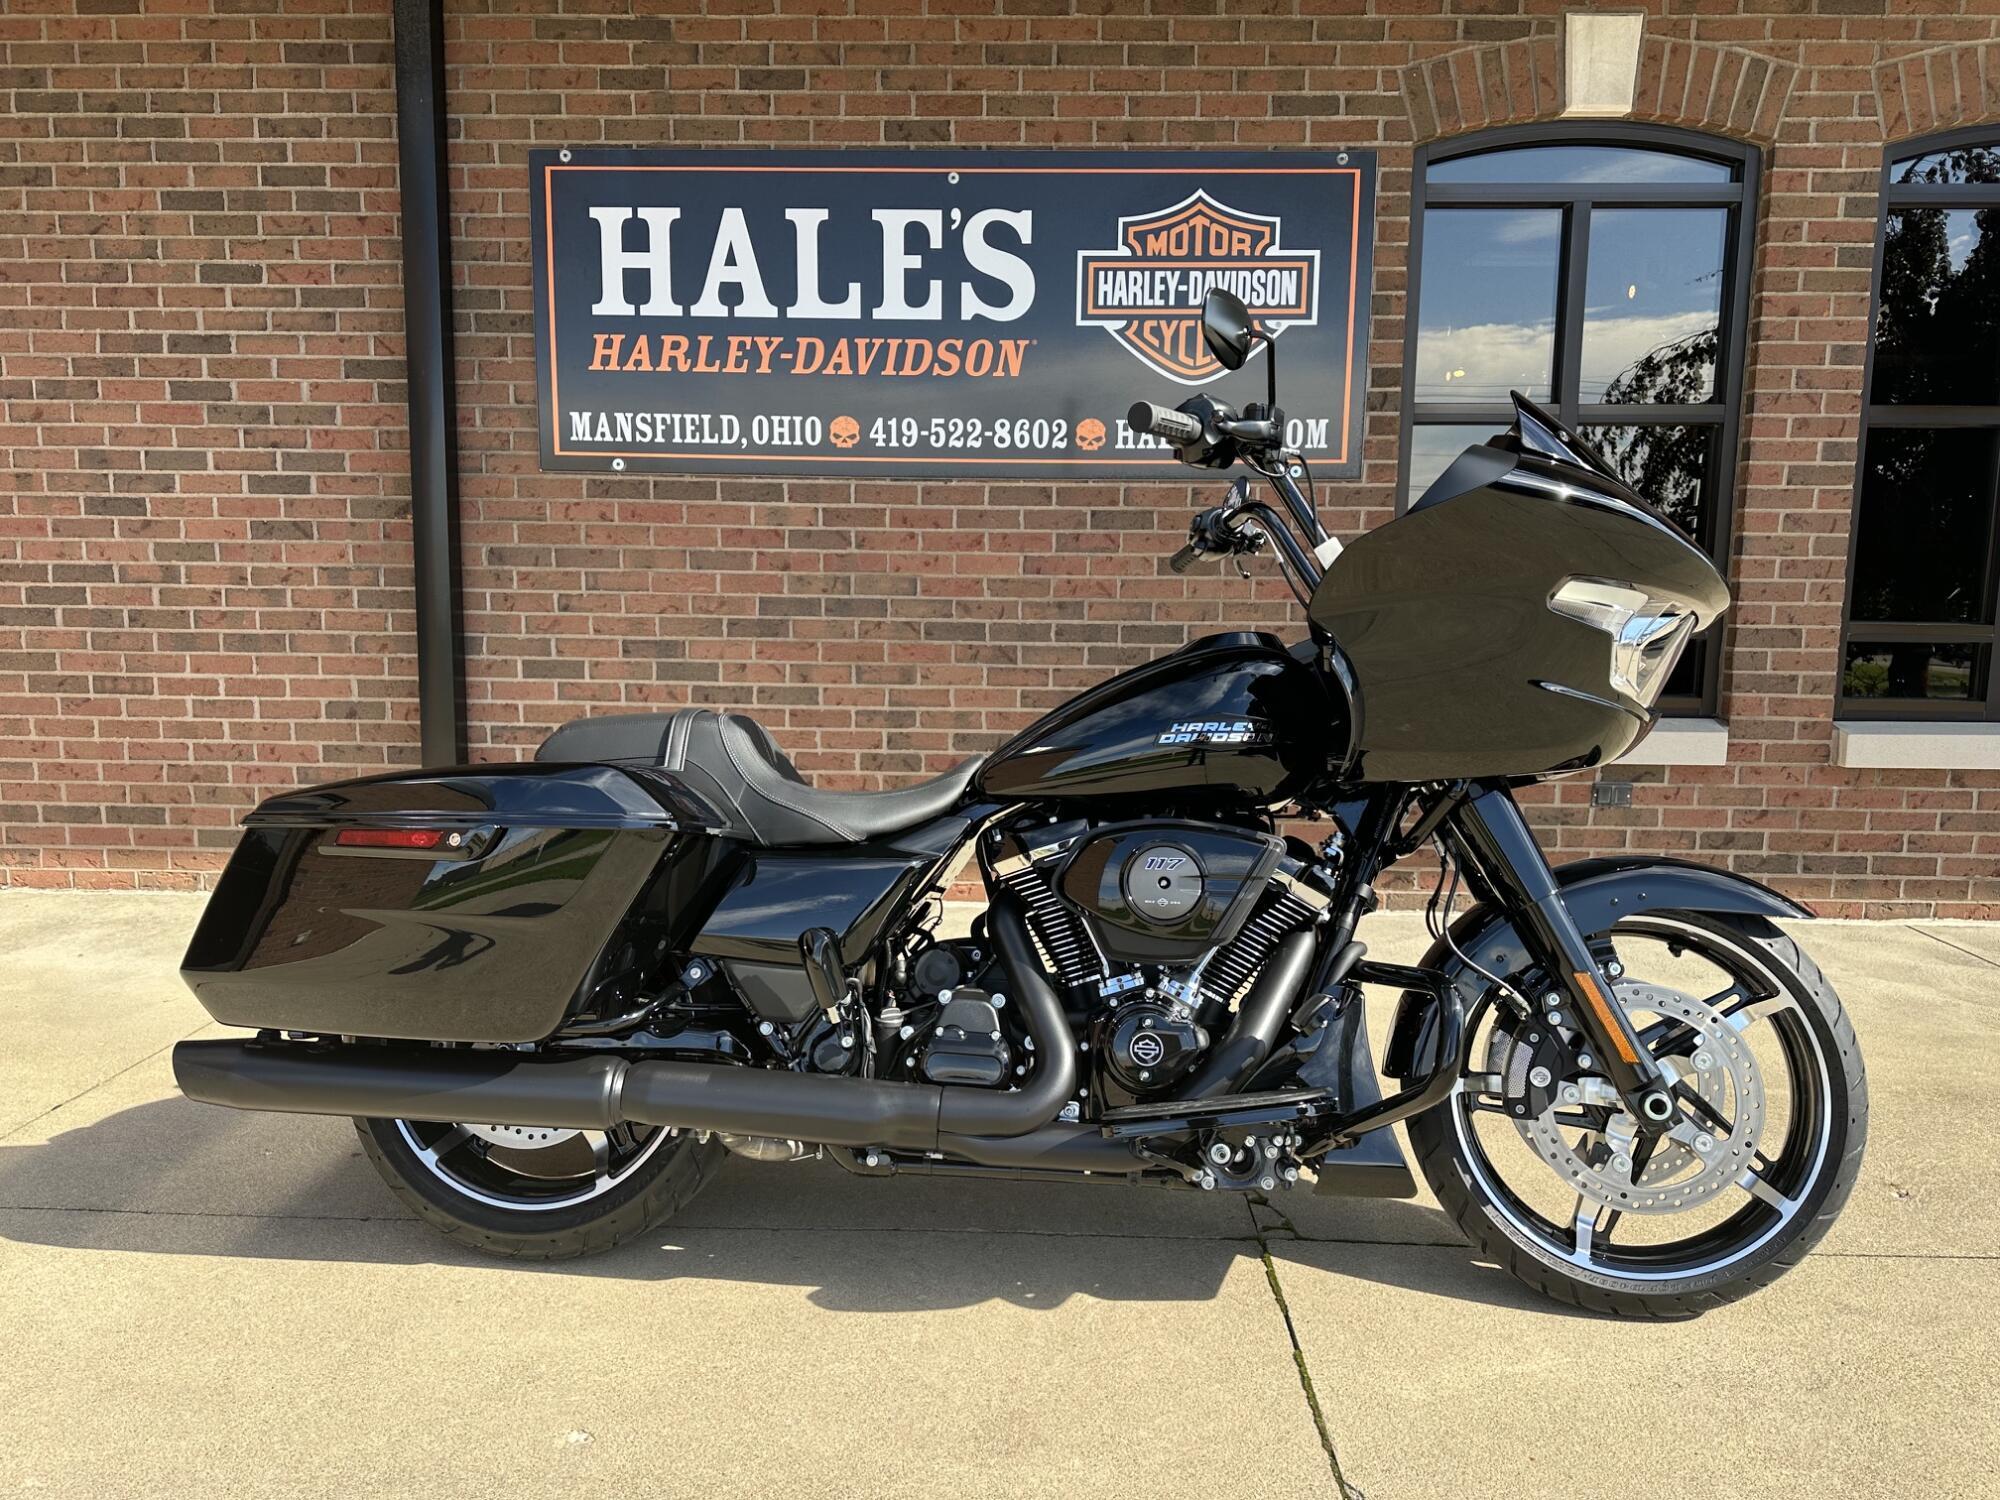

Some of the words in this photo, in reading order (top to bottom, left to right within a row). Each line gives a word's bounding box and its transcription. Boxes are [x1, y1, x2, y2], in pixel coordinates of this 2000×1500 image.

[1146, 214, 1252, 257] MOTOR
[588, 206, 1037, 322] HALE'S
[587, 333, 1033, 378] HARLEY-DAVIDSON
[1142, 319, 1218, 367] CYCL
[869, 416, 1068, 449] 419-522-8602
[1144, 856, 1187, 871] 117
